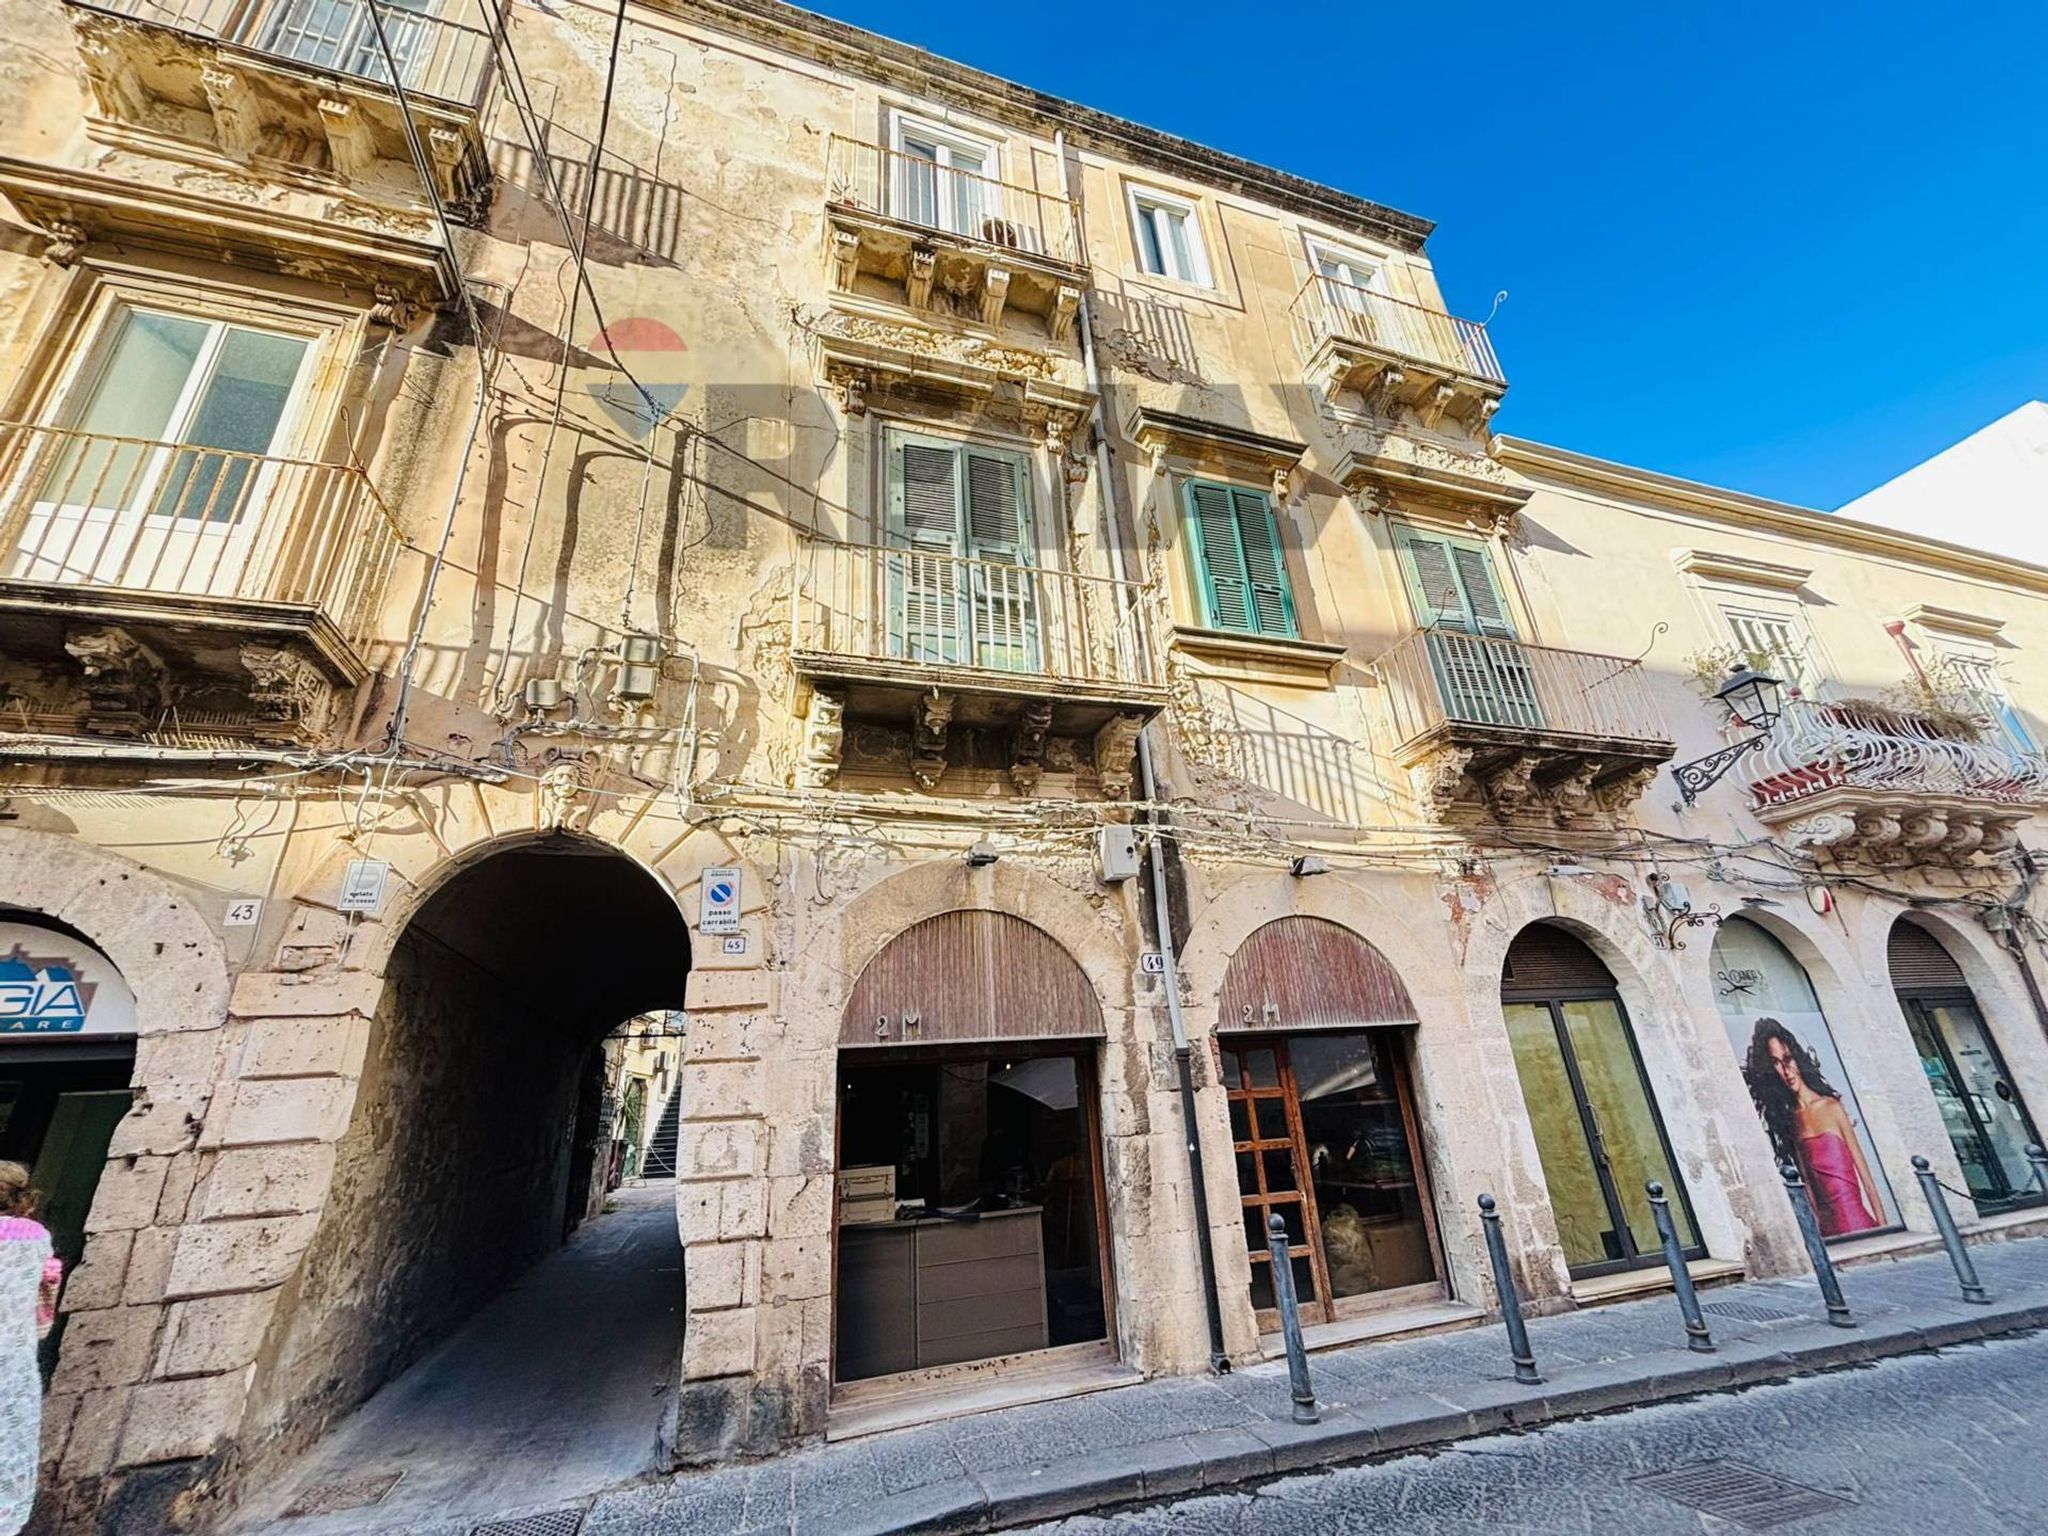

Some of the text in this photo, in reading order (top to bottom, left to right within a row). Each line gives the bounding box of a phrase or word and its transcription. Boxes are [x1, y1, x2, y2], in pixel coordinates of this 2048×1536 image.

[231, 905, 255, 920] 43
[727, 941, 740, 950] 45
[1147, 956, 1164, 969] 49
[1242, 1004, 1256, 1023] 2
[875, 1012, 921, 1039] 2 M
